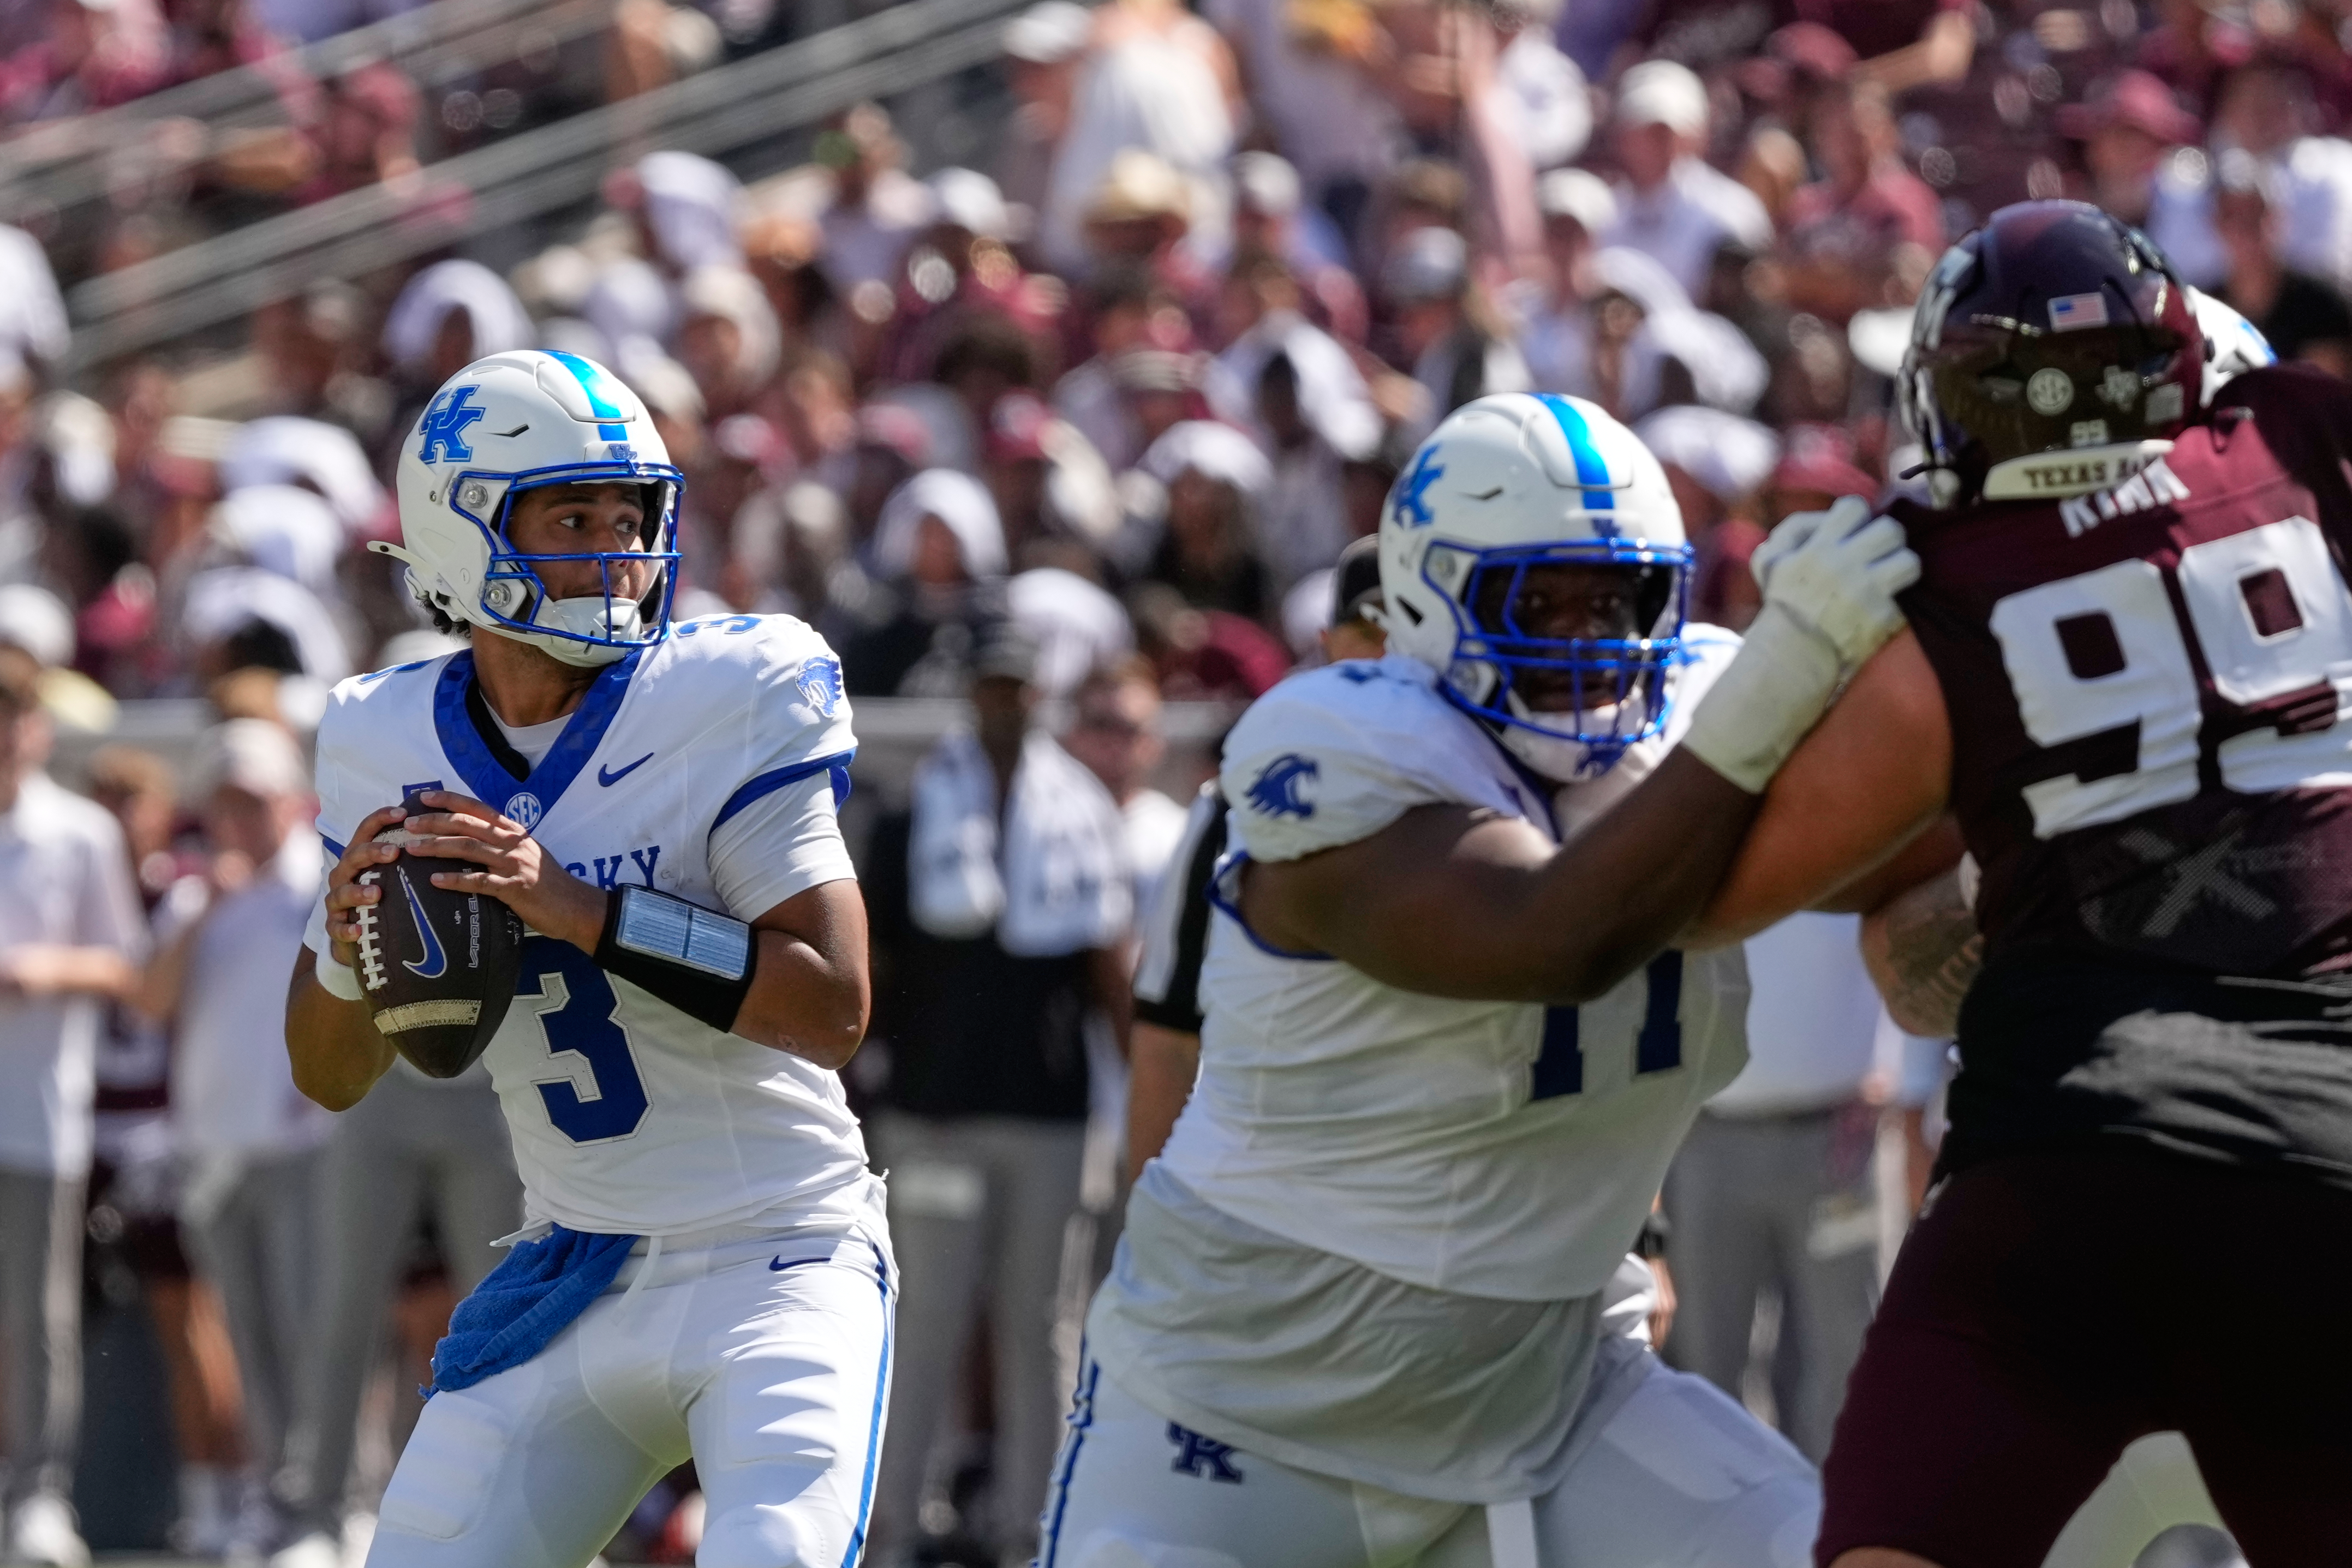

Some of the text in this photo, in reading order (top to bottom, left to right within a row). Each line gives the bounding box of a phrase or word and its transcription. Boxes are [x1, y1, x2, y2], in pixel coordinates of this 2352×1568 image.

[419, 384, 486, 464] UK
[2023, 460, 2107, 489] TEXAS
[1988, 514, 2352, 841] 99
[508, 794, 539, 828] SEC
[462, 867, 480, 968] VAPOR ELE
[508, 925, 653, 1148] 3
